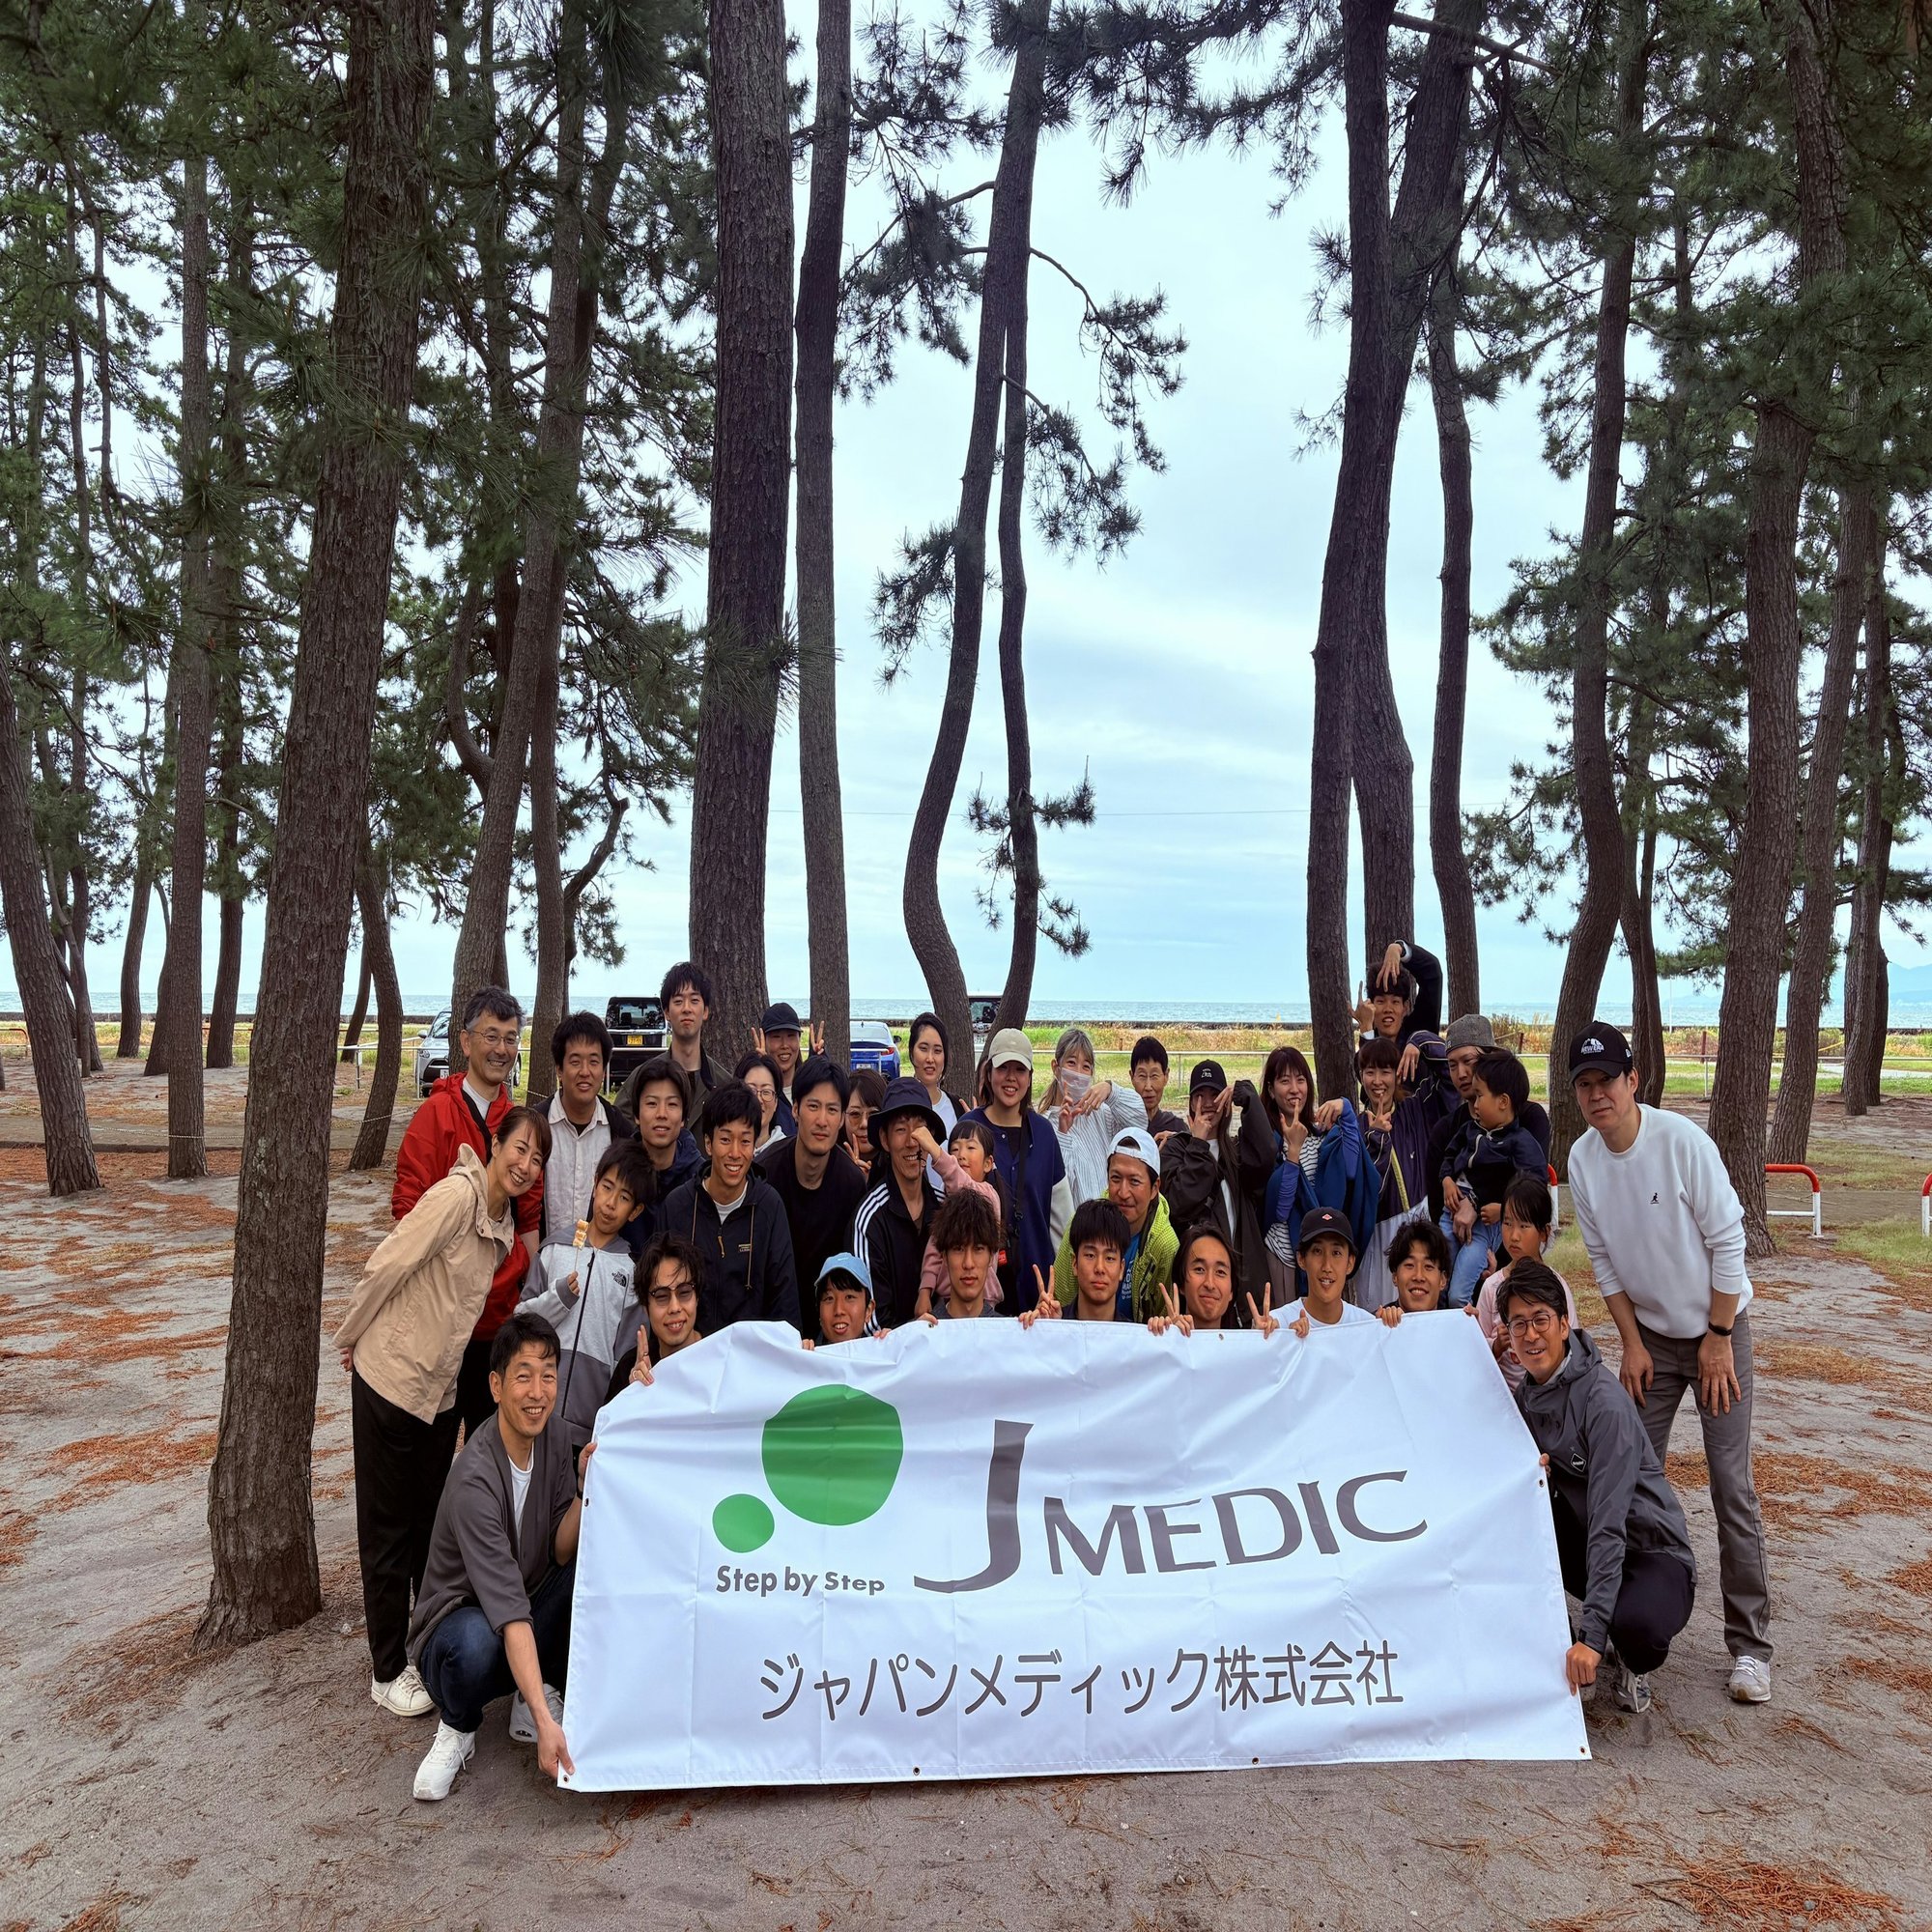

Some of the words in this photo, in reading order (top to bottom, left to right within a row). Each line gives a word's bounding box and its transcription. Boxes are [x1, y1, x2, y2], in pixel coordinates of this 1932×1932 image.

[716, 1565, 778, 1597] Step
[783, 1566, 818, 1597] by
[824, 1572, 885, 1596] Step
[760, 1639, 1404, 1720] ジャパンメディック株式会社
